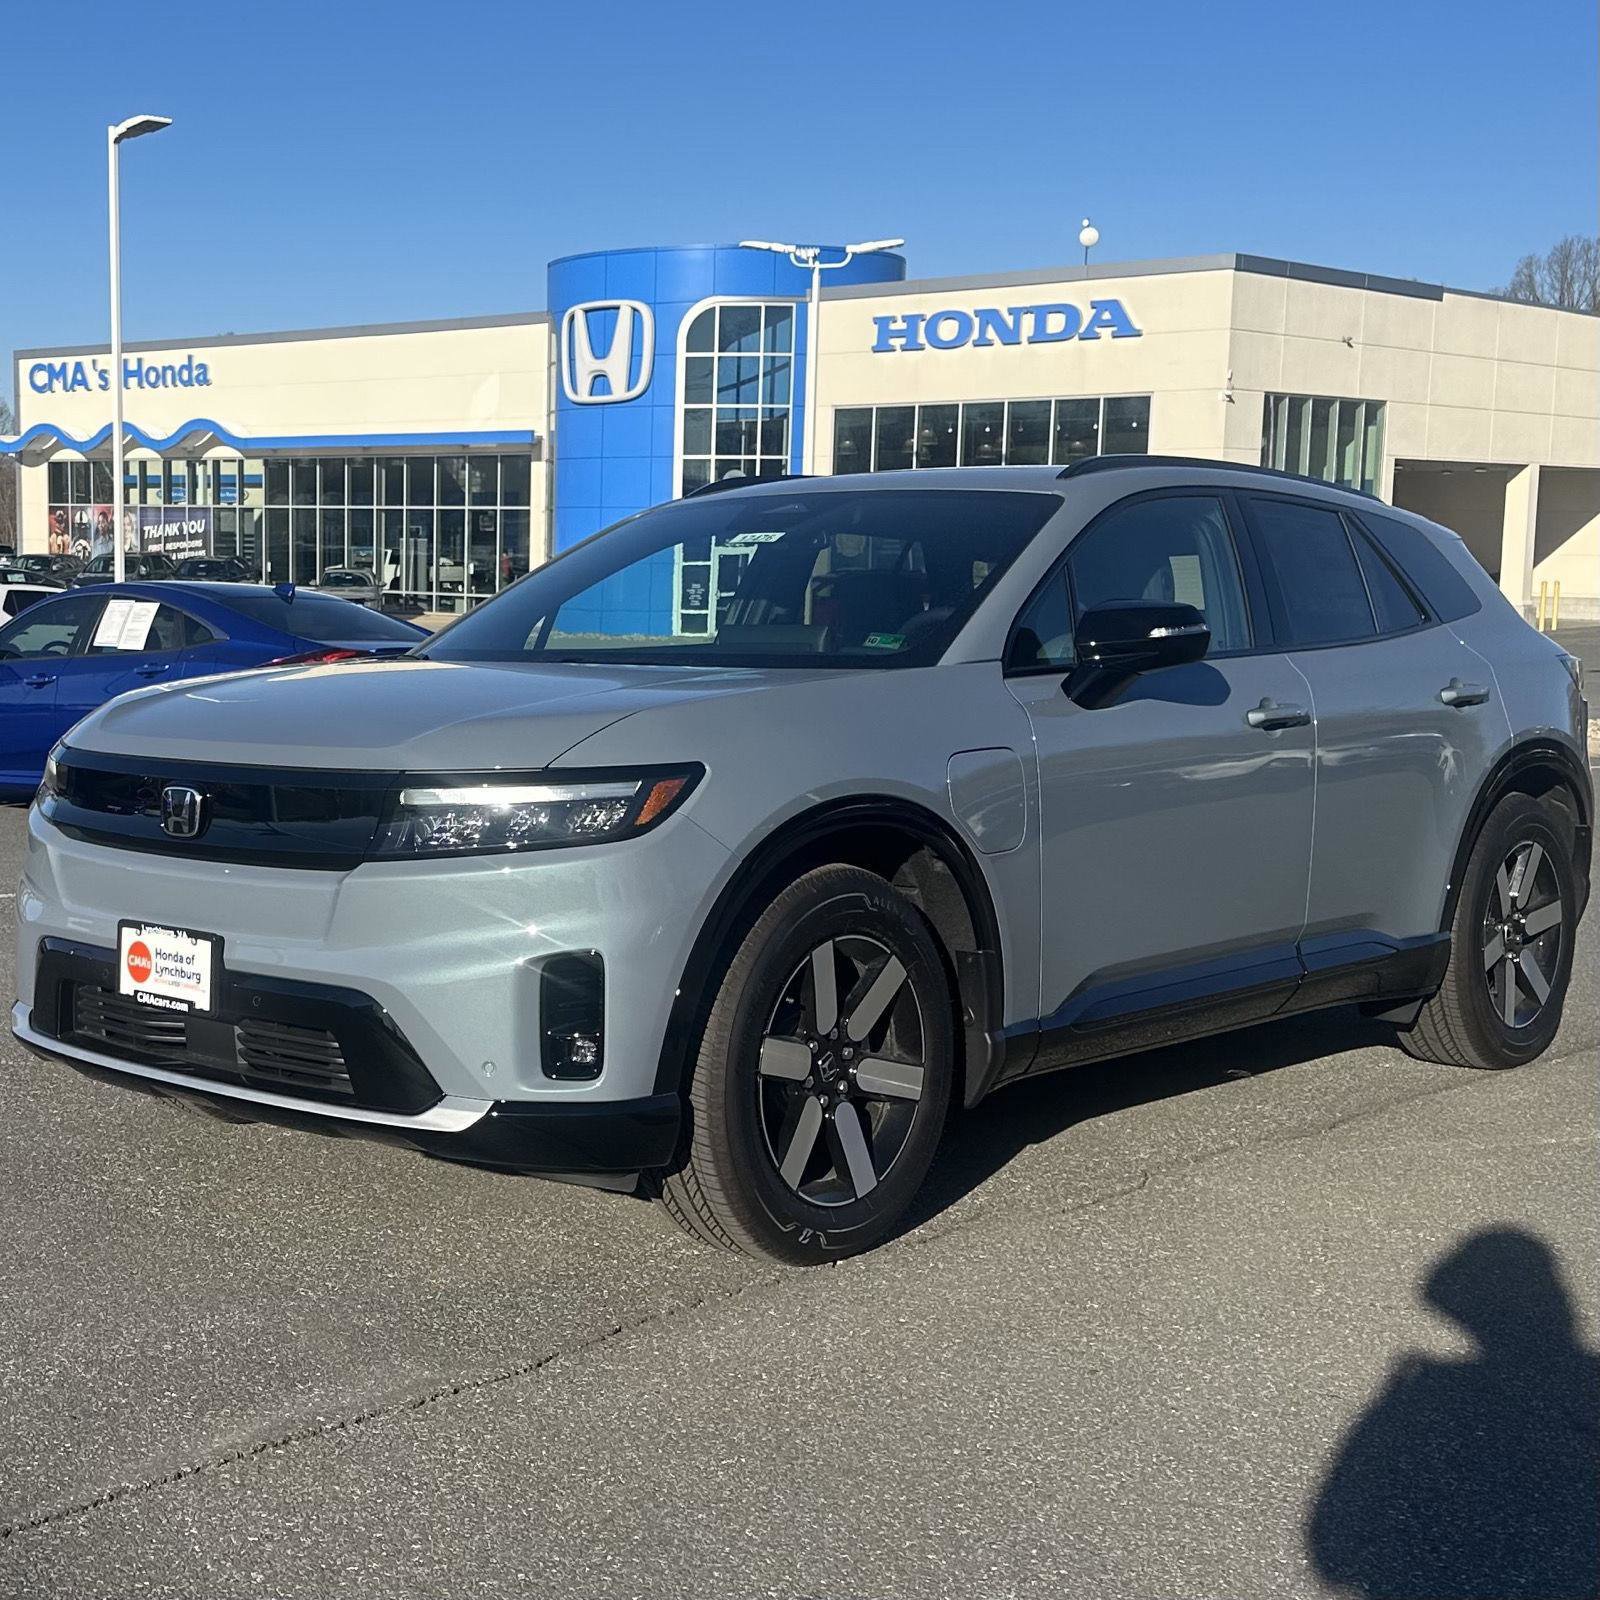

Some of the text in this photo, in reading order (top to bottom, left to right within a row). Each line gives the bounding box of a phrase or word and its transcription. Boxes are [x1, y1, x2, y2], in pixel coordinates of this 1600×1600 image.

[871, 298, 1143, 353] HONDA
[29, 354, 212, 393] CMA's Honda
[143, 519, 205, 539] THANK YOU
[156, 948, 195, 964] Honda of
[155, 963, 201, 983] Lynchburg
[137, 992, 188, 1012] CMAcars.com
